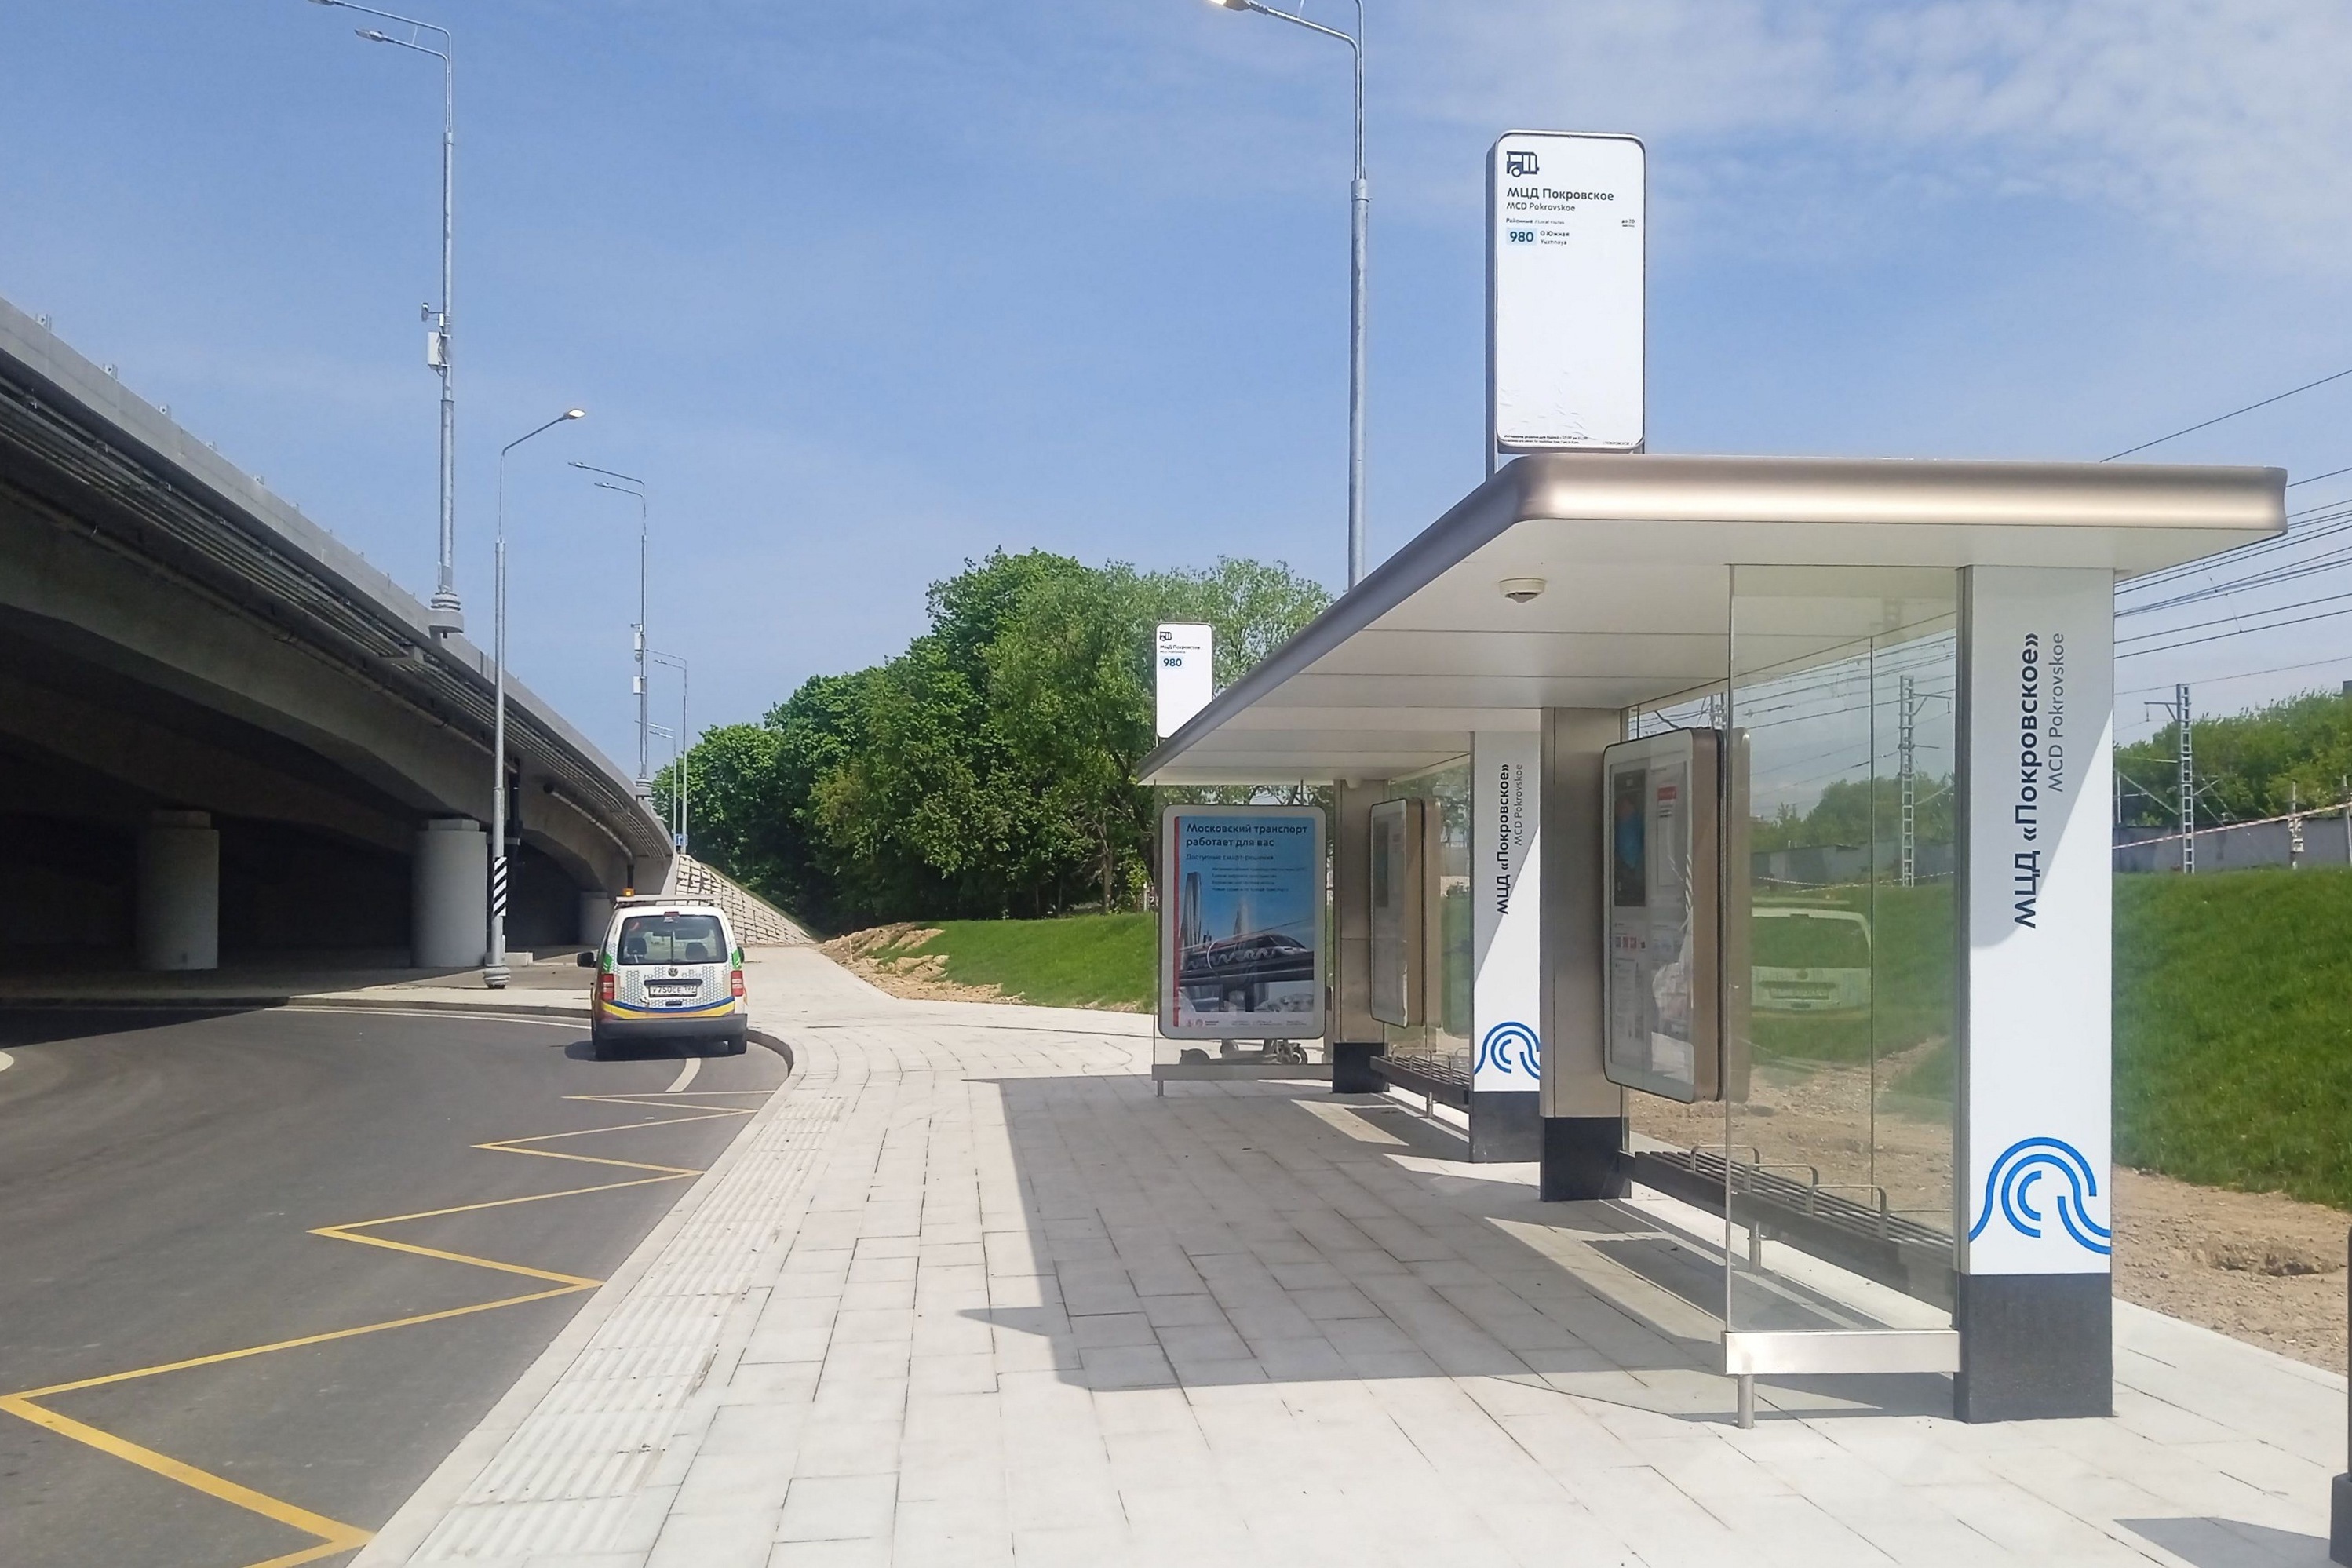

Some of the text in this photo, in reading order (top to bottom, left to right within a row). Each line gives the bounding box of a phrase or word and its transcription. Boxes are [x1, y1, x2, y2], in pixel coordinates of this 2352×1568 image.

[1507, 188, 1614, 201] МЦД Покровское
[1530, 202, 1576, 211] Pokrovskoe
[1509, 231, 1534, 242] 980
[1163, 658, 1182, 667] 980
[2048, 633, 2064, 793] MCD Pokrovskoe
[2014, 633, 2042, 929] МЦД «Покровское»
[1514, 764, 1523, 846] MCD Pokrovskoe
[1186, 823, 1307, 835] Московский транспорт
[1186, 837, 1234, 848] работает
[1497, 764, 1511, 914] МЦД «Покровское»
